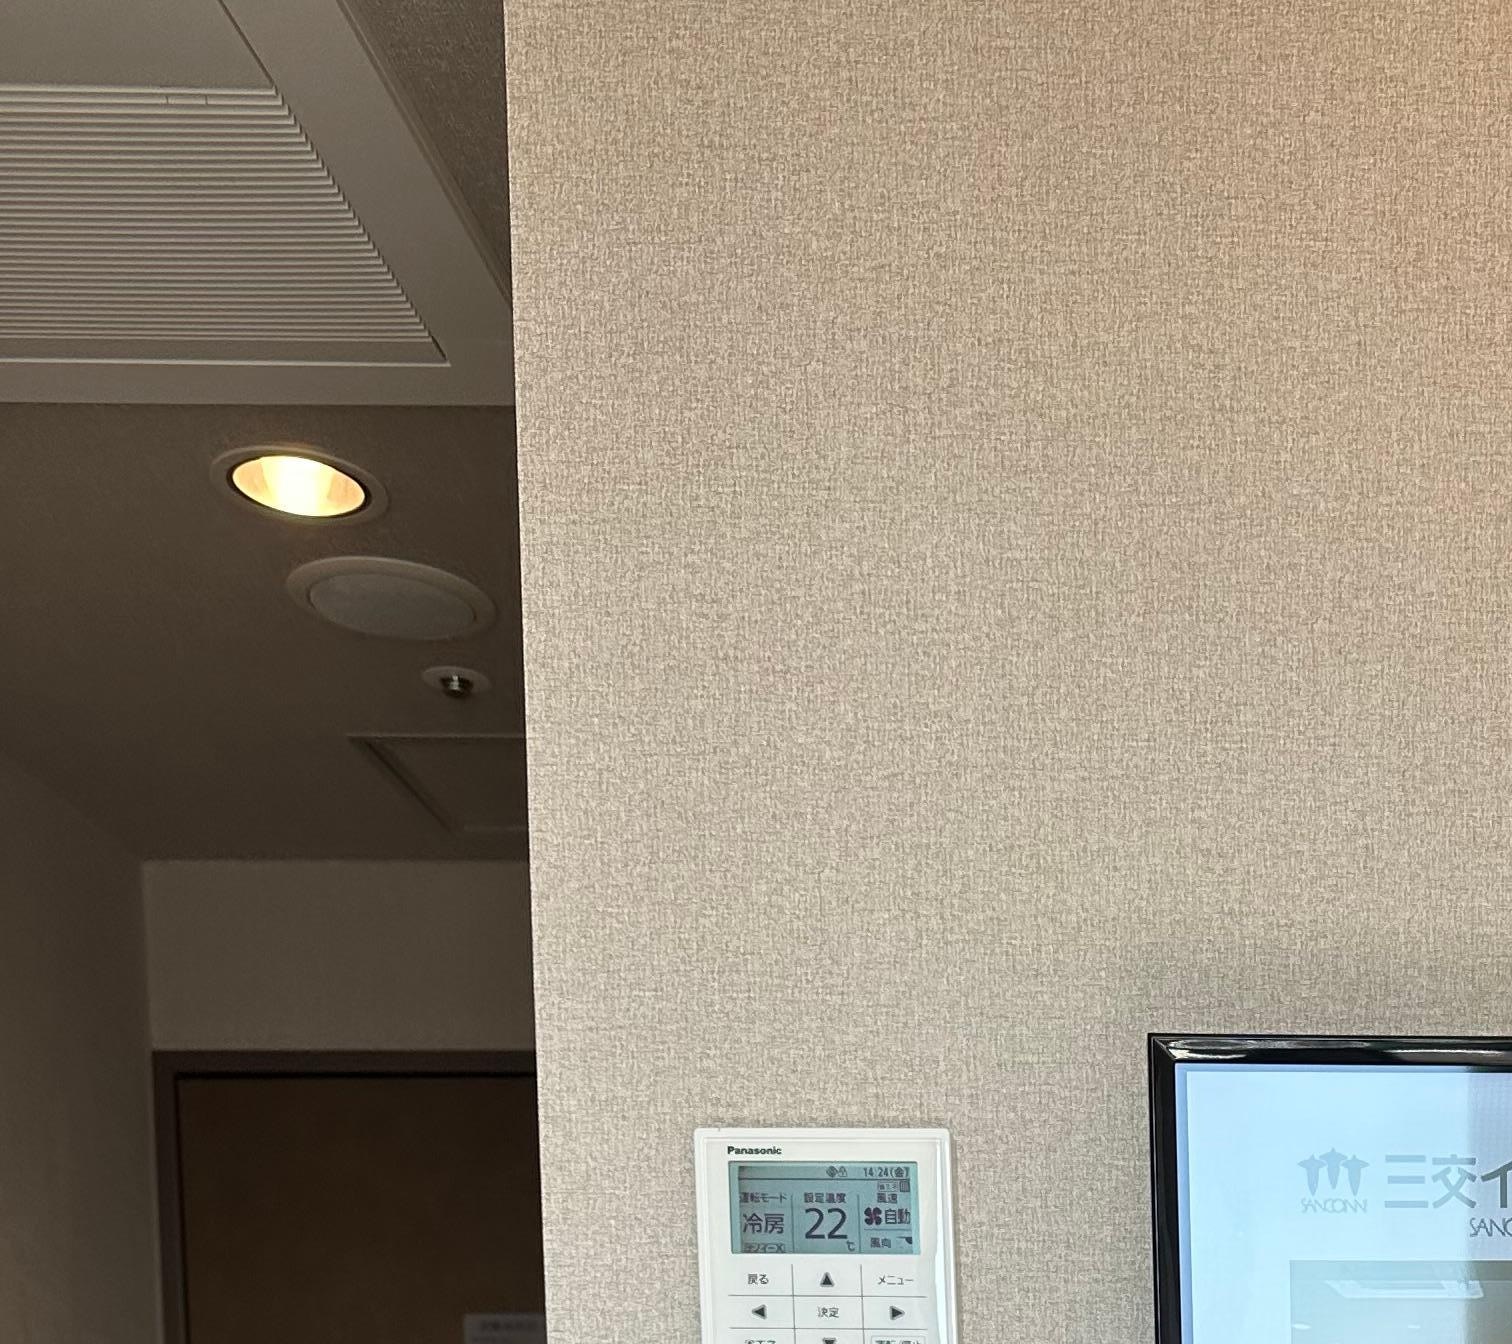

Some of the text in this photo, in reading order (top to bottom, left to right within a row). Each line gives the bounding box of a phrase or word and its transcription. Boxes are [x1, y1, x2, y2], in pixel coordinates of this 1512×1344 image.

[727, 1145, 782, 1156] Panasonic
[742, 1212, 785, 1234] 冷房
[884, 1208, 911, 1225] 自動
[804, 1207, 848, 1240] 22
[747, 1273, 769, 1285] 戻る
[878, 1275, 914, 1286] メニュー
[817, 1306, 840, 1319] 決定
